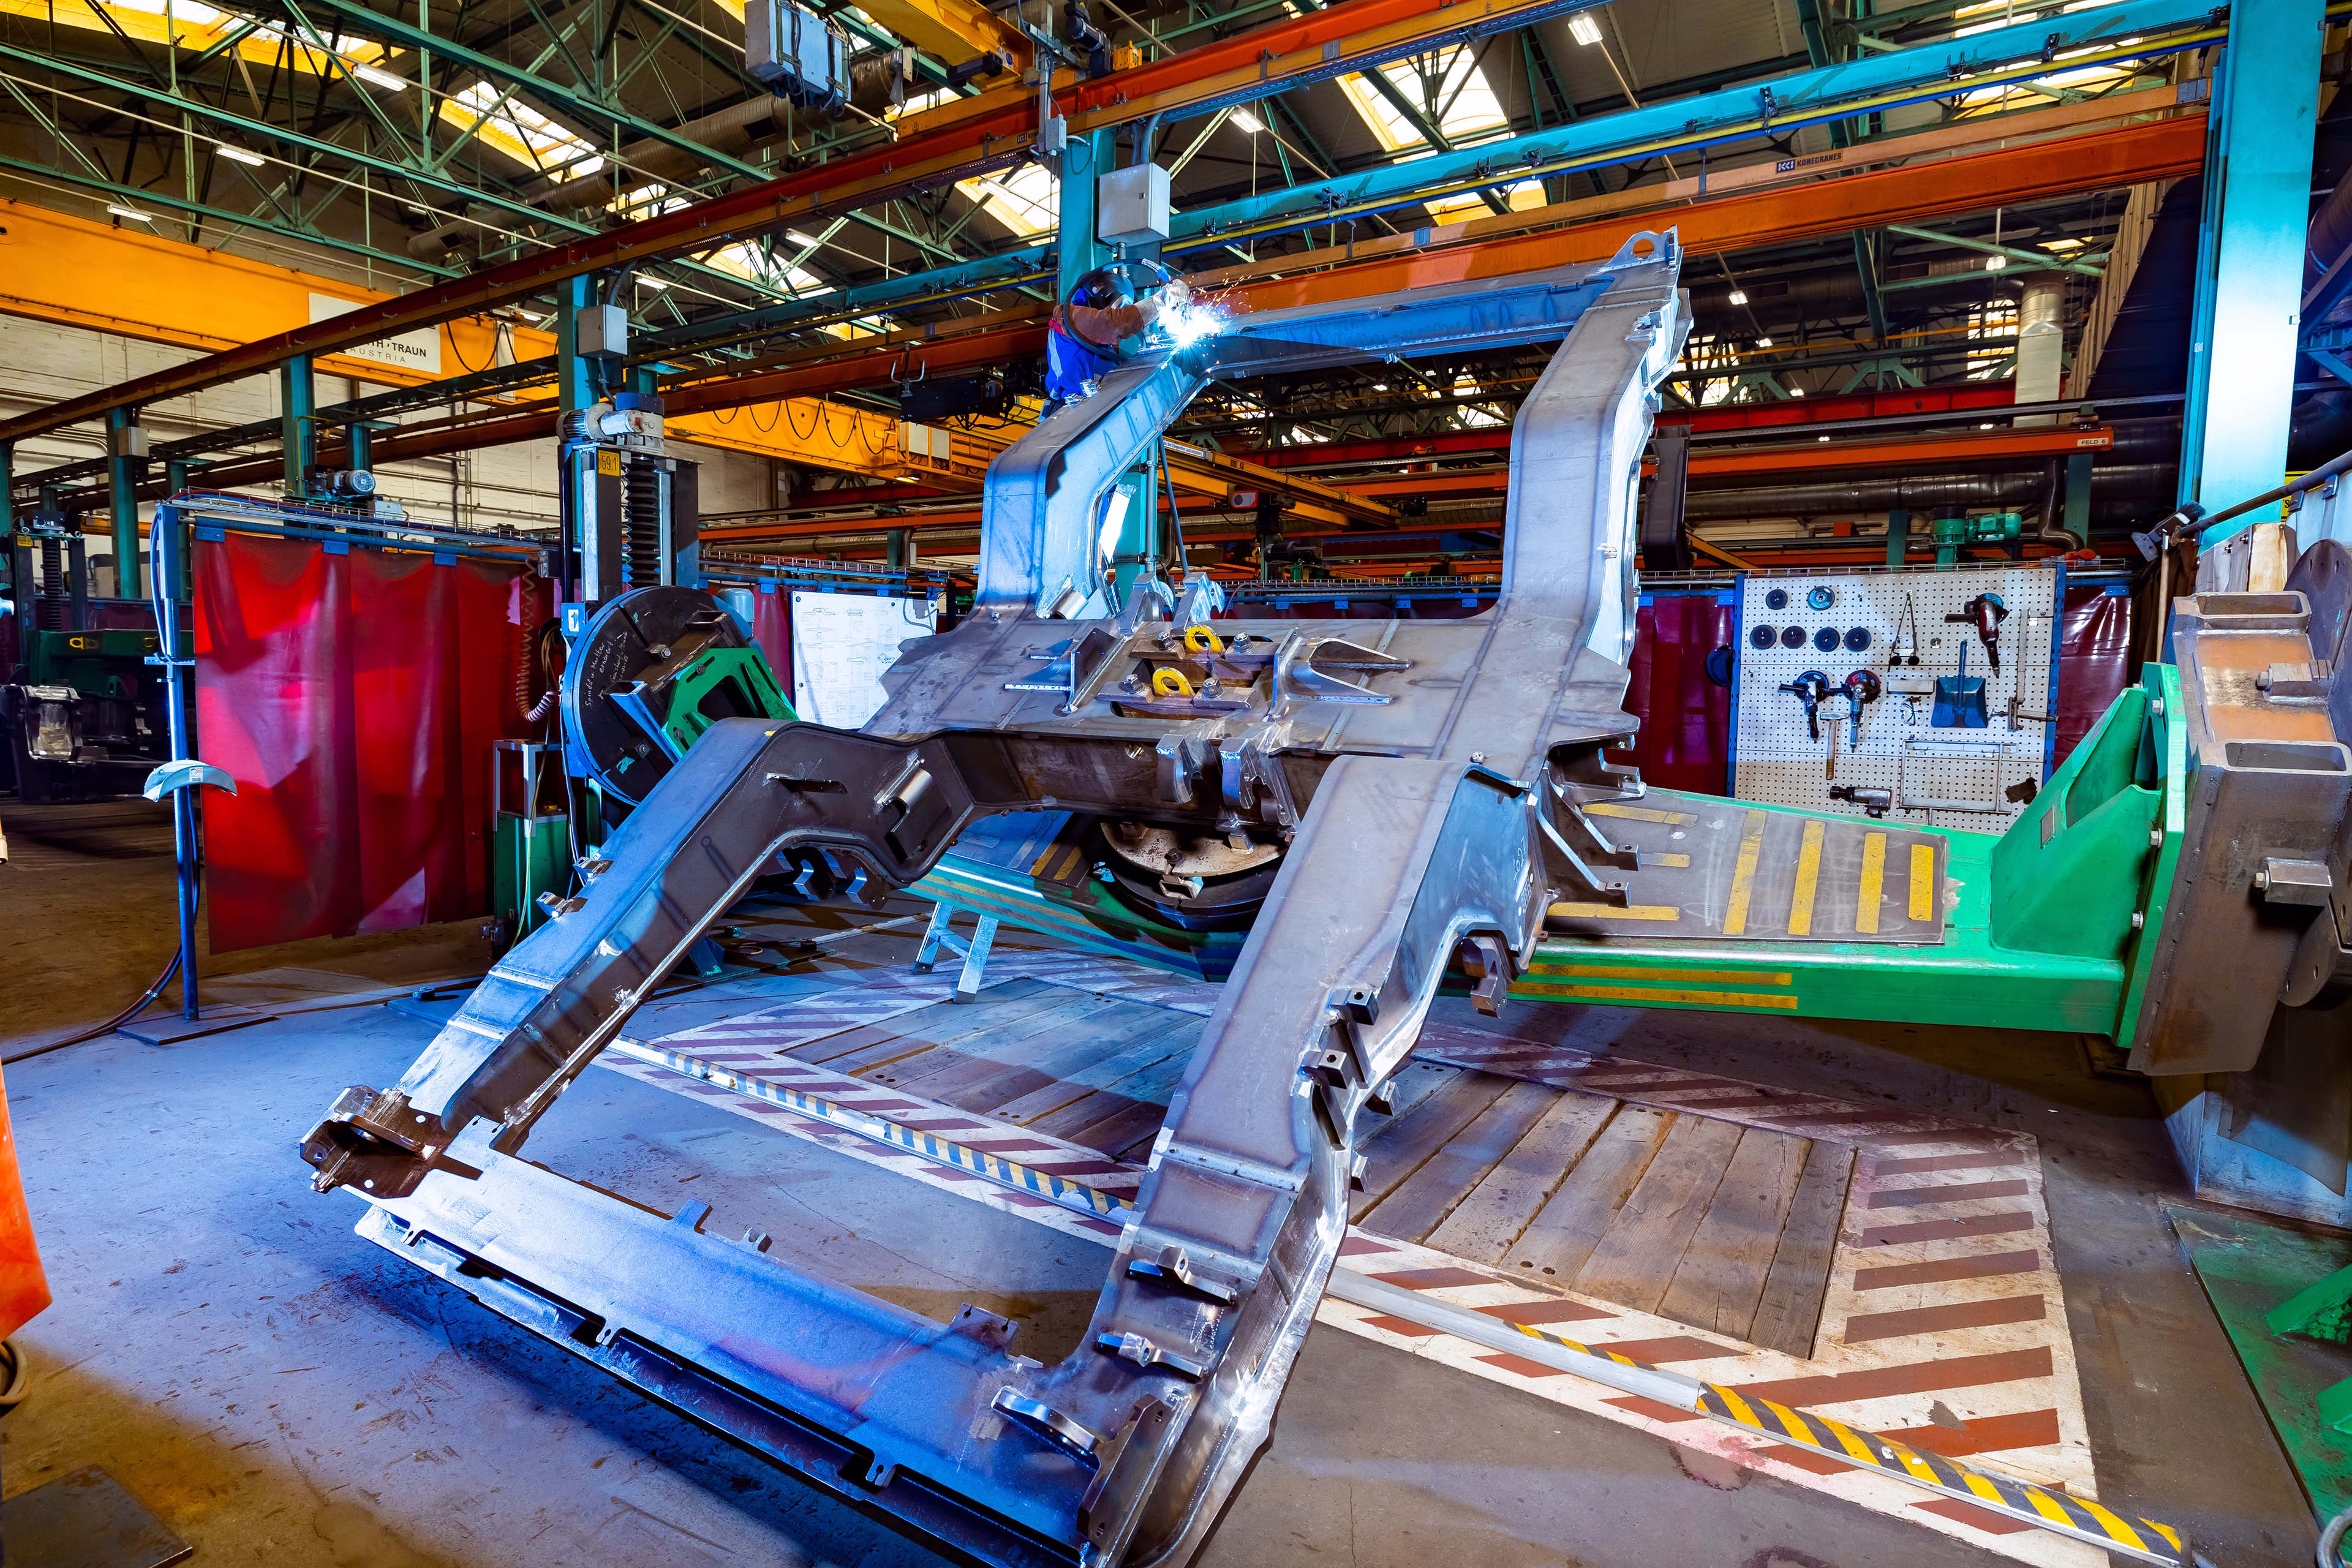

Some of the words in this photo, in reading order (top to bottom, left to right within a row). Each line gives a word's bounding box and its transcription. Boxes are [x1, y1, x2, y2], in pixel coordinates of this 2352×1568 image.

[1796, 153, 1842, 167] KONECRANES
[350, 347, 406, 363] AUSTRIA
[601, 455, 617, 471] 59.1
[571, 611, 578, 629] 1
[590, 642, 605, 669] Mutter
